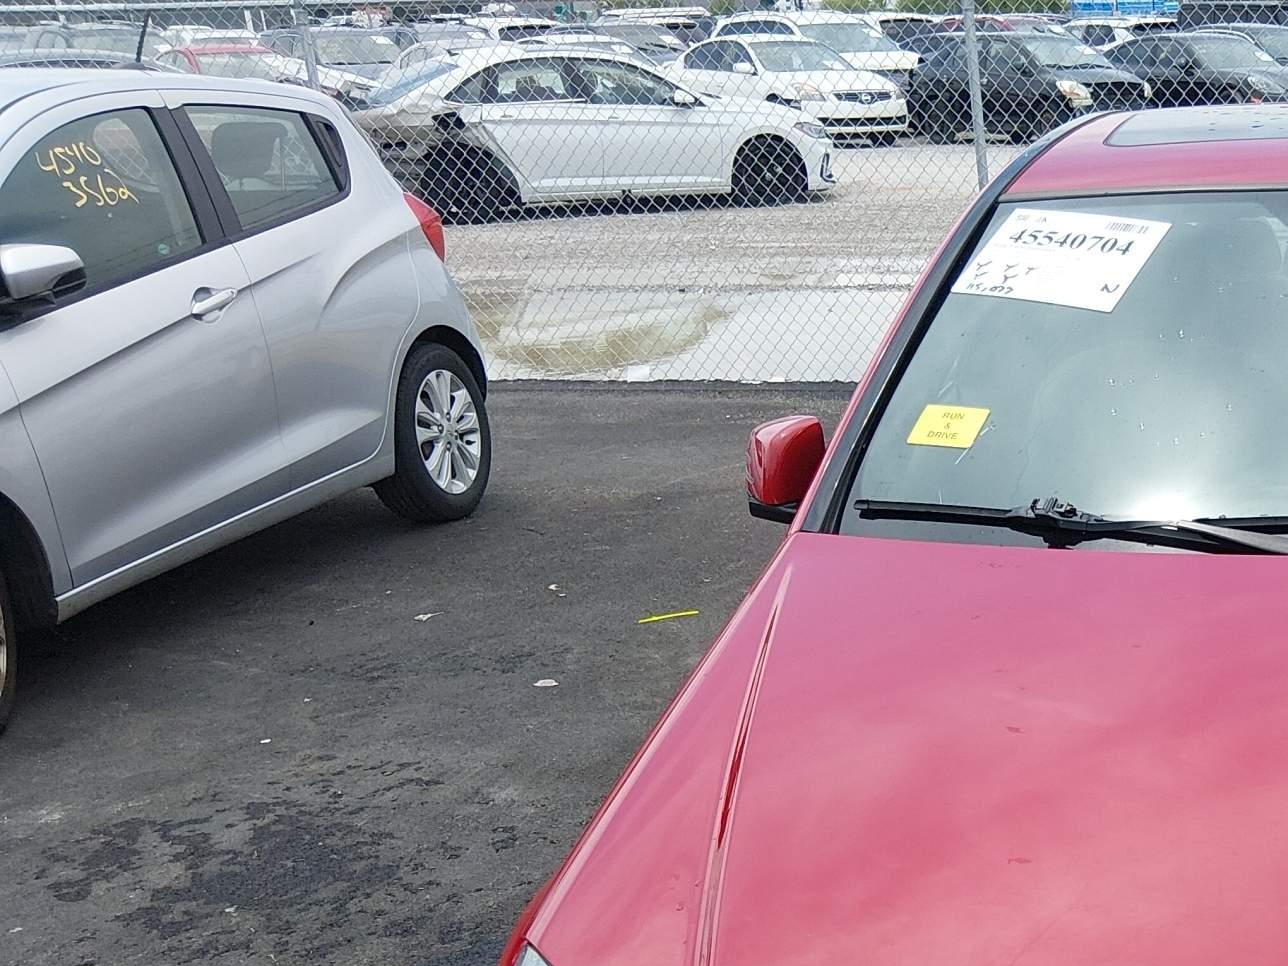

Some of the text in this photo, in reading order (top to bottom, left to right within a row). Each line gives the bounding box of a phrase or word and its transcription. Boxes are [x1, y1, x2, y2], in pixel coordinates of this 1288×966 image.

[35, 142, 101, 176] 4540
[1009, 228, 1135, 256] 45540704
[942, 412, 965, 420] RUN
[926, 430, 959, 440] DRIVE
